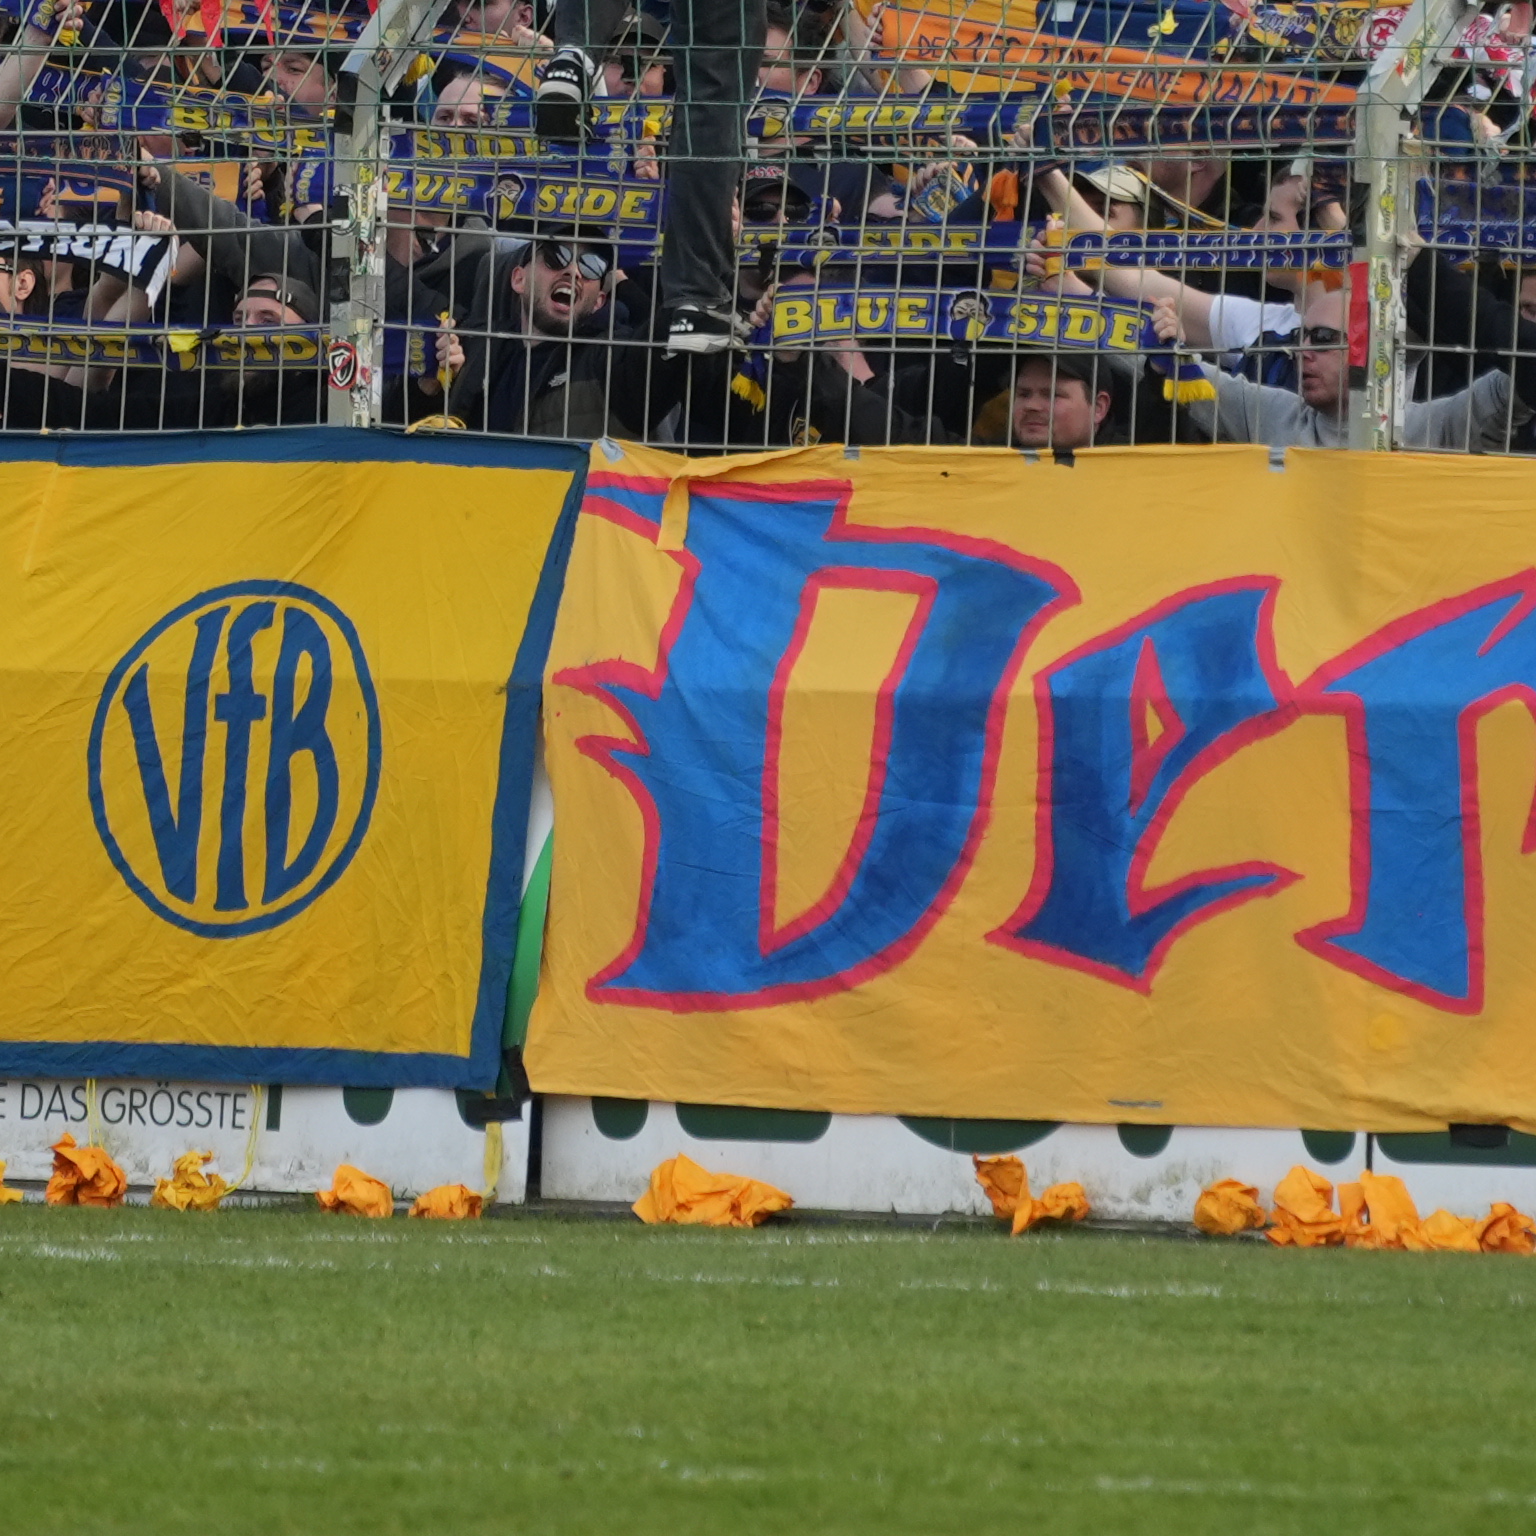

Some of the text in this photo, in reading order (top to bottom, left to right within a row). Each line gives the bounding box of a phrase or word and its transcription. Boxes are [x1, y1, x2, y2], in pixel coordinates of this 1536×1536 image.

[809, 105, 969, 131] SIDE
[386, 170, 655, 220] LUE SIDE
[852, 232, 978, 259] SIDE
[772, 296, 1147, 352] BLUE SIDE
[121, 599, 340, 912] VfB
[19, 1081, 89, 1123] DAS
